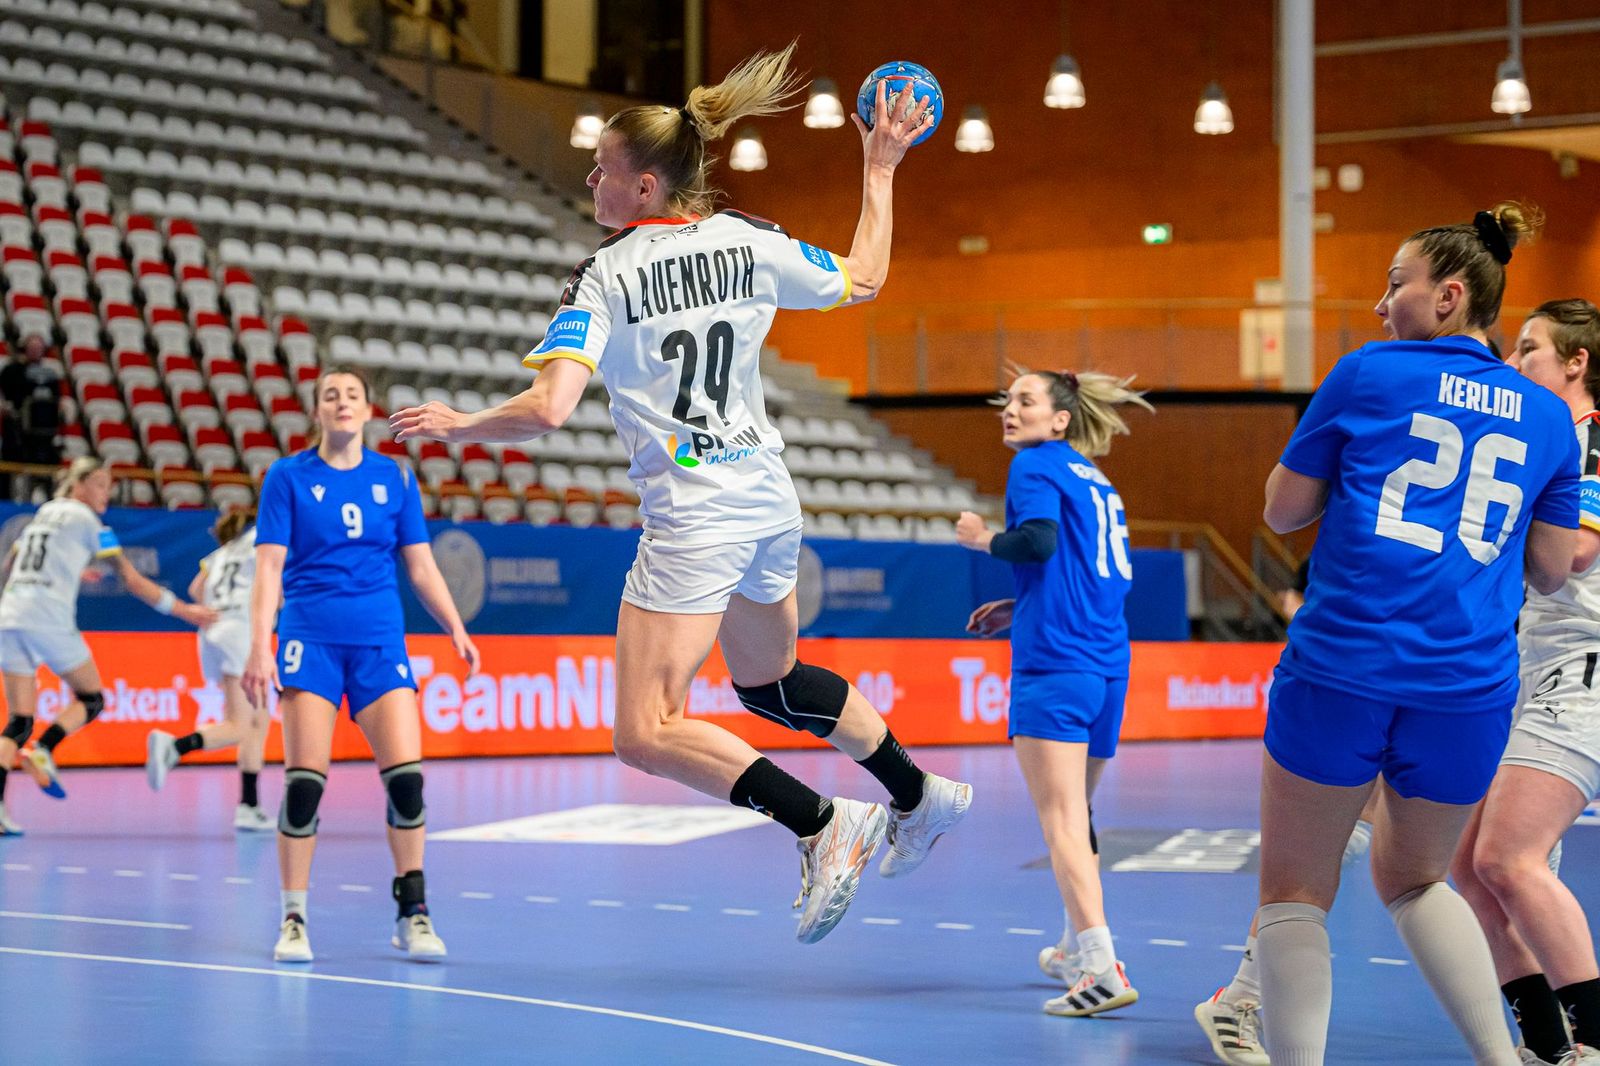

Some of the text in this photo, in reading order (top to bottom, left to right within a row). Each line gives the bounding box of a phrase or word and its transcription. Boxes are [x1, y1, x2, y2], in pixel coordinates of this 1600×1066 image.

[616, 246, 756, 325] LAUENROTH
[660, 320, 735, 430] 29
[1439, 372, 1523, 422] KERLIDI
[1375, 412, 1529, 566] 26
[1580, 488, 1600, 502] pix
[341, 502, 363, 539] 9
[284, 639, 304, 675] 9
[37, 681, 180, 722] eieken
[950, 657, 1011, 725] Te
